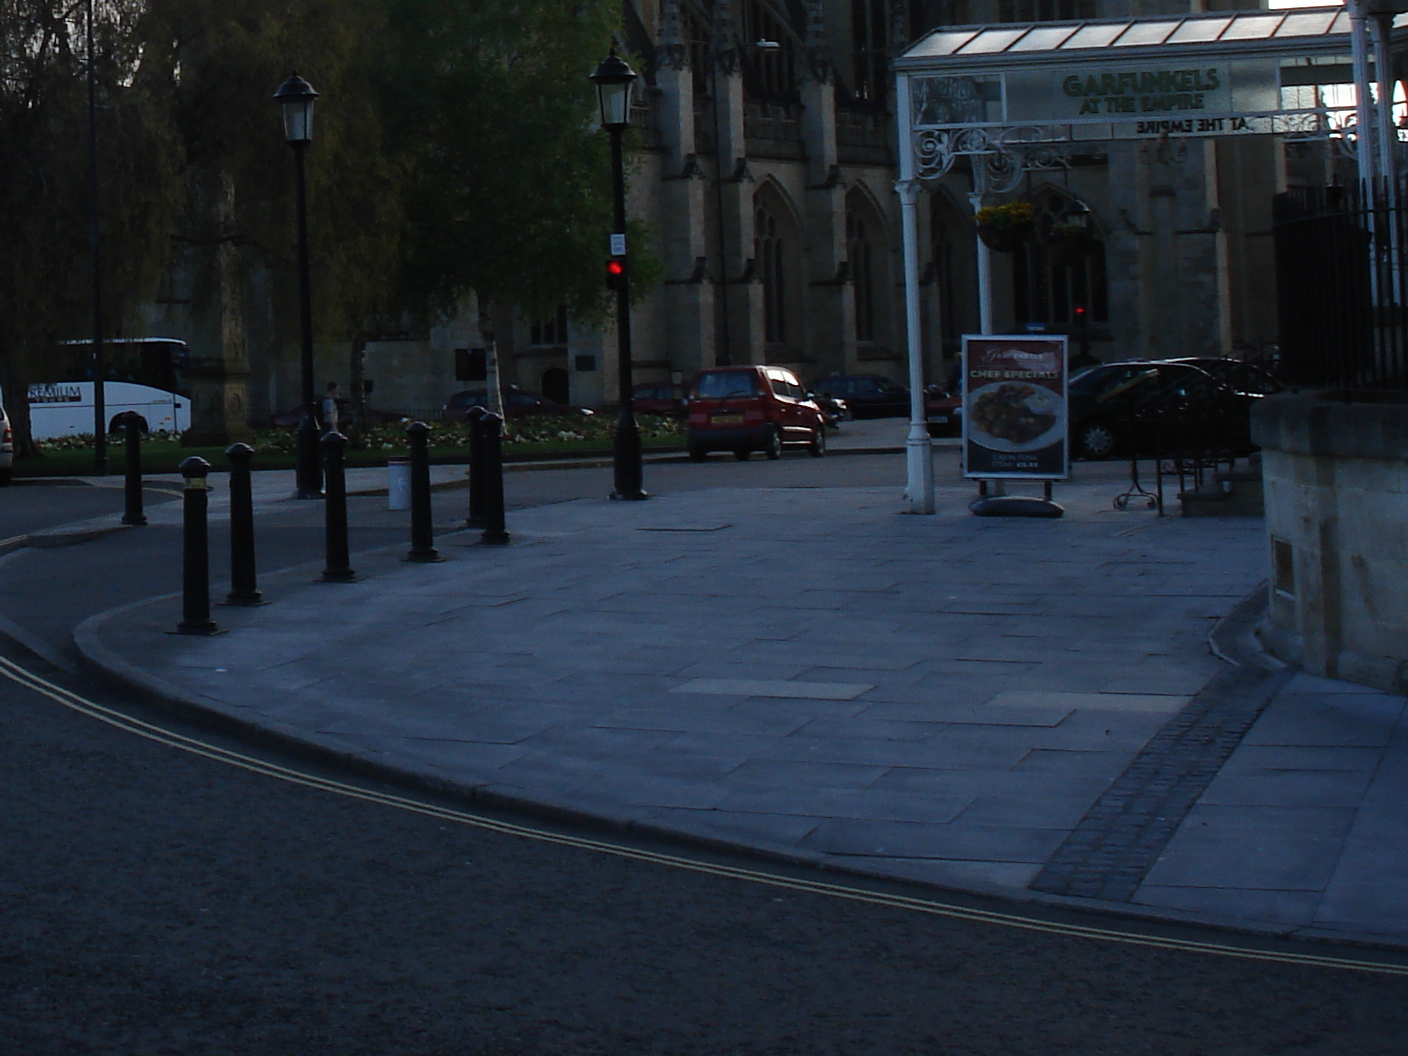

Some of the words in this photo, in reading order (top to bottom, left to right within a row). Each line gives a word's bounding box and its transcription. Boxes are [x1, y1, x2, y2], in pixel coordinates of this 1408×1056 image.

[1062, 68, 1220, 97] GARFUNKELS
[1079, 98, 1102, 115] AT
[1105, 96, 1136, 114] THE
[1140, 93, 1205, 112] EMPIRE
[969, 369, 1001, 379] CHEF
[1004, 370, 1059, 379] SPECIALS
